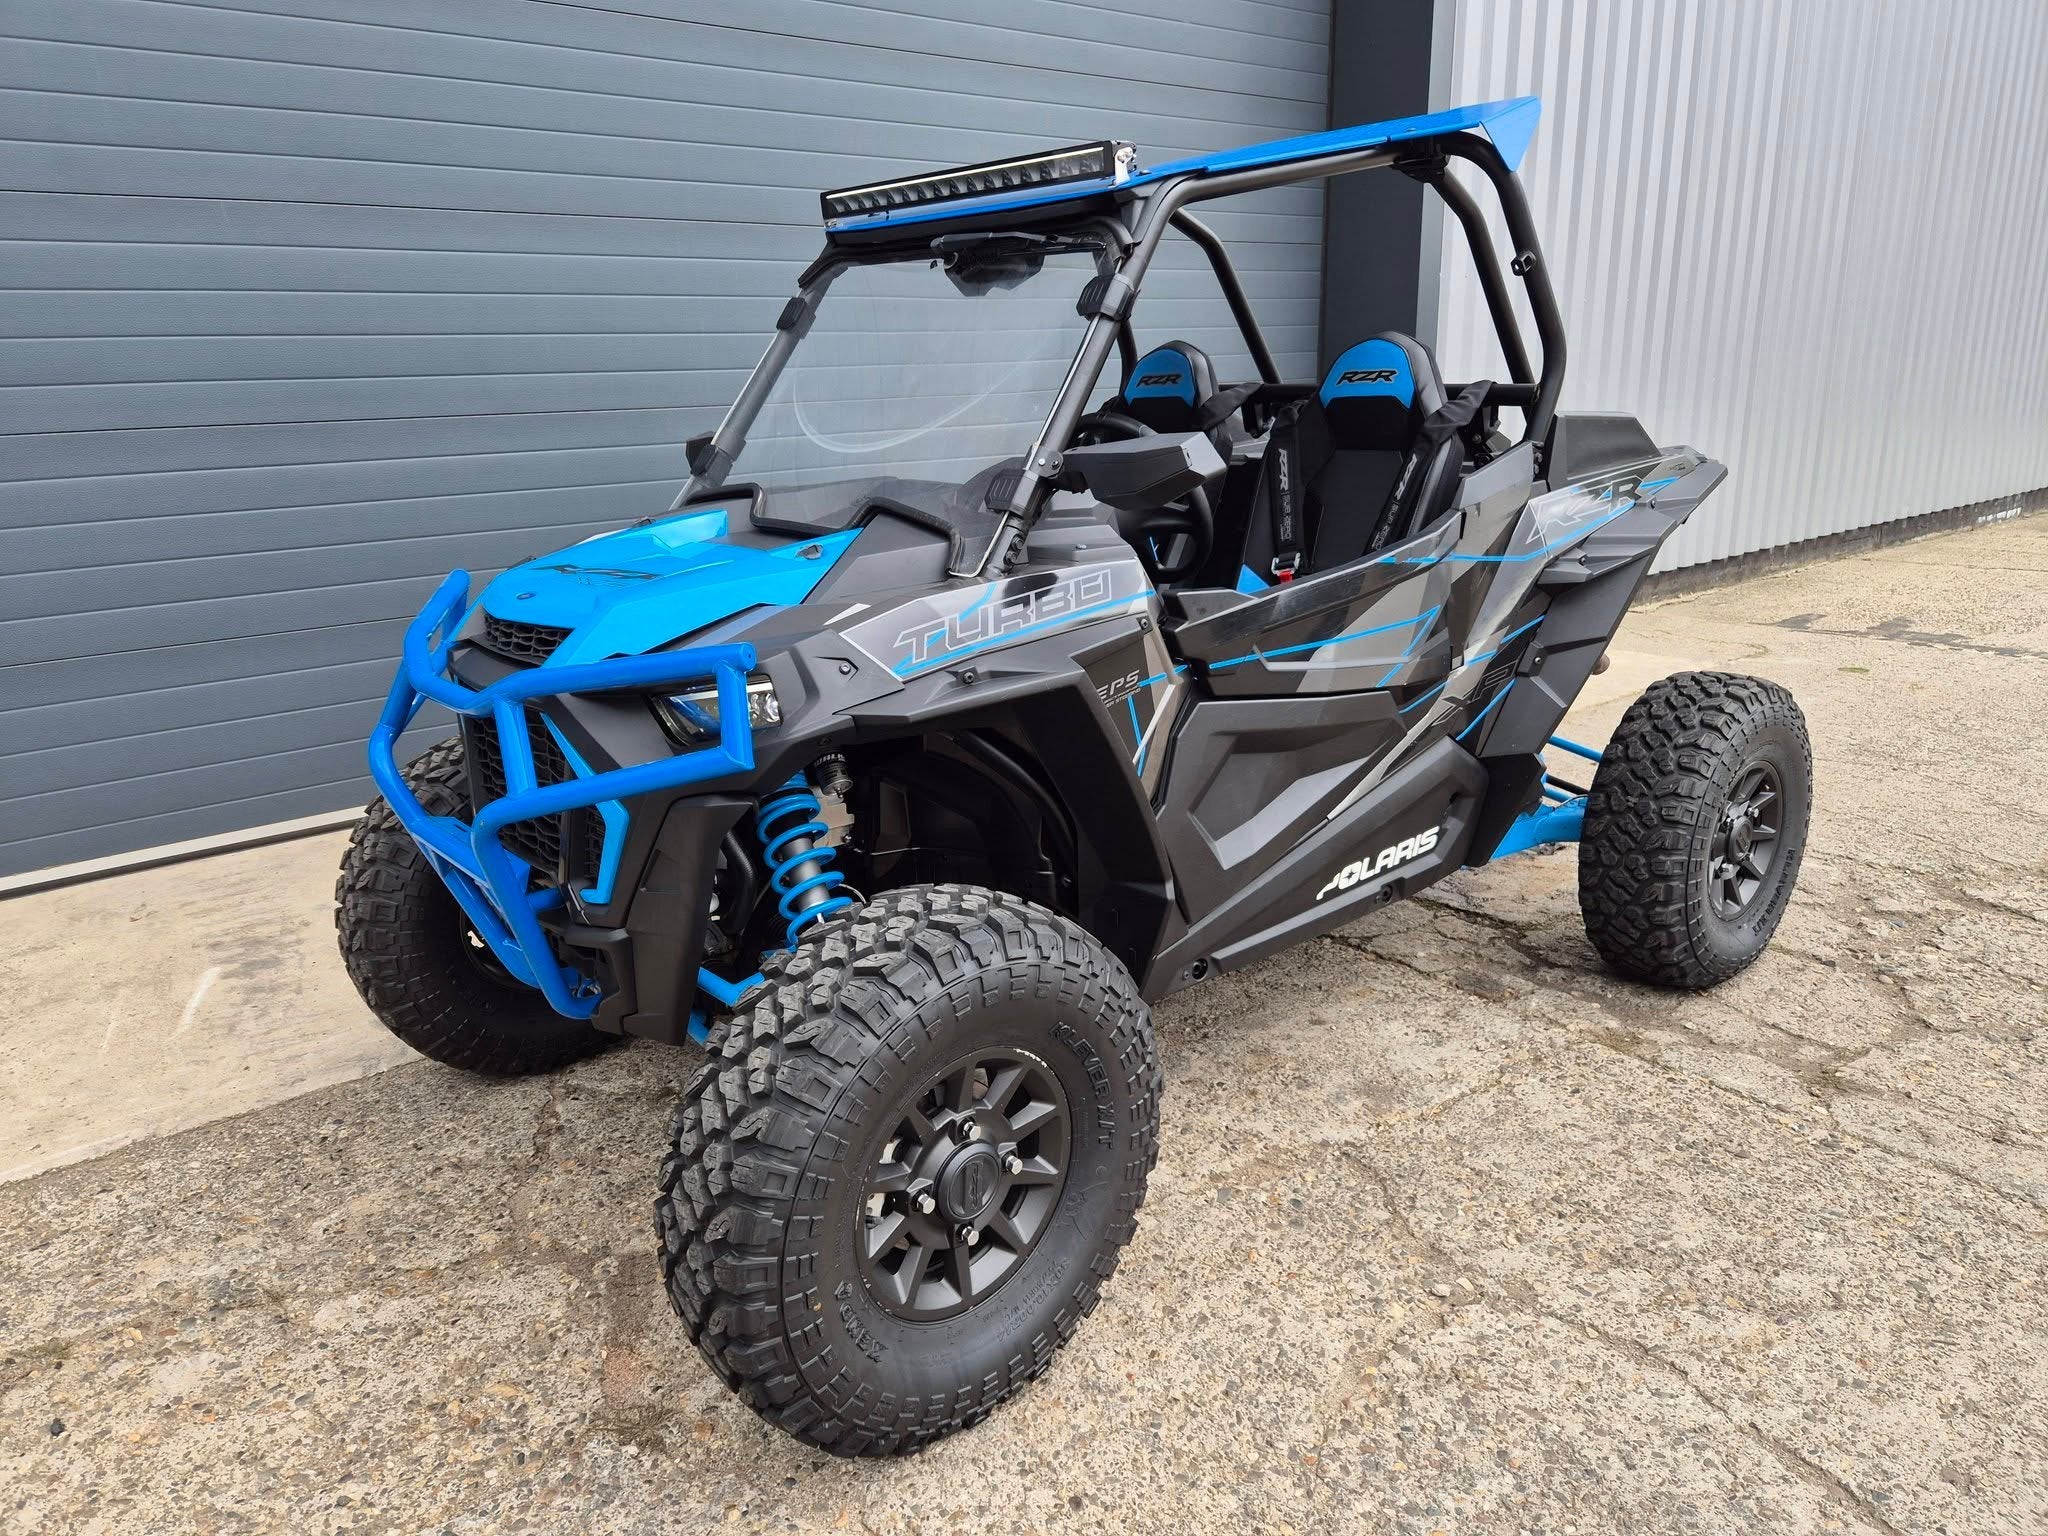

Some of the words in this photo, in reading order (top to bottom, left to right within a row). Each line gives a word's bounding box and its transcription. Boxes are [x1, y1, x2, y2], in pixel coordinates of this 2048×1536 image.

[1136, 374, 1183, 388] RZR
[1335, 370, 1398, 385] RZR
[1279, 448, 1289, 491] RZR
[893, 568, 1112, 664] TURBO
[1096, 669, 1140, 700] EPS
[1316, 825, 1440, 900] POLARIS
[1048, 1021, 1112, 1100] KLEVER
